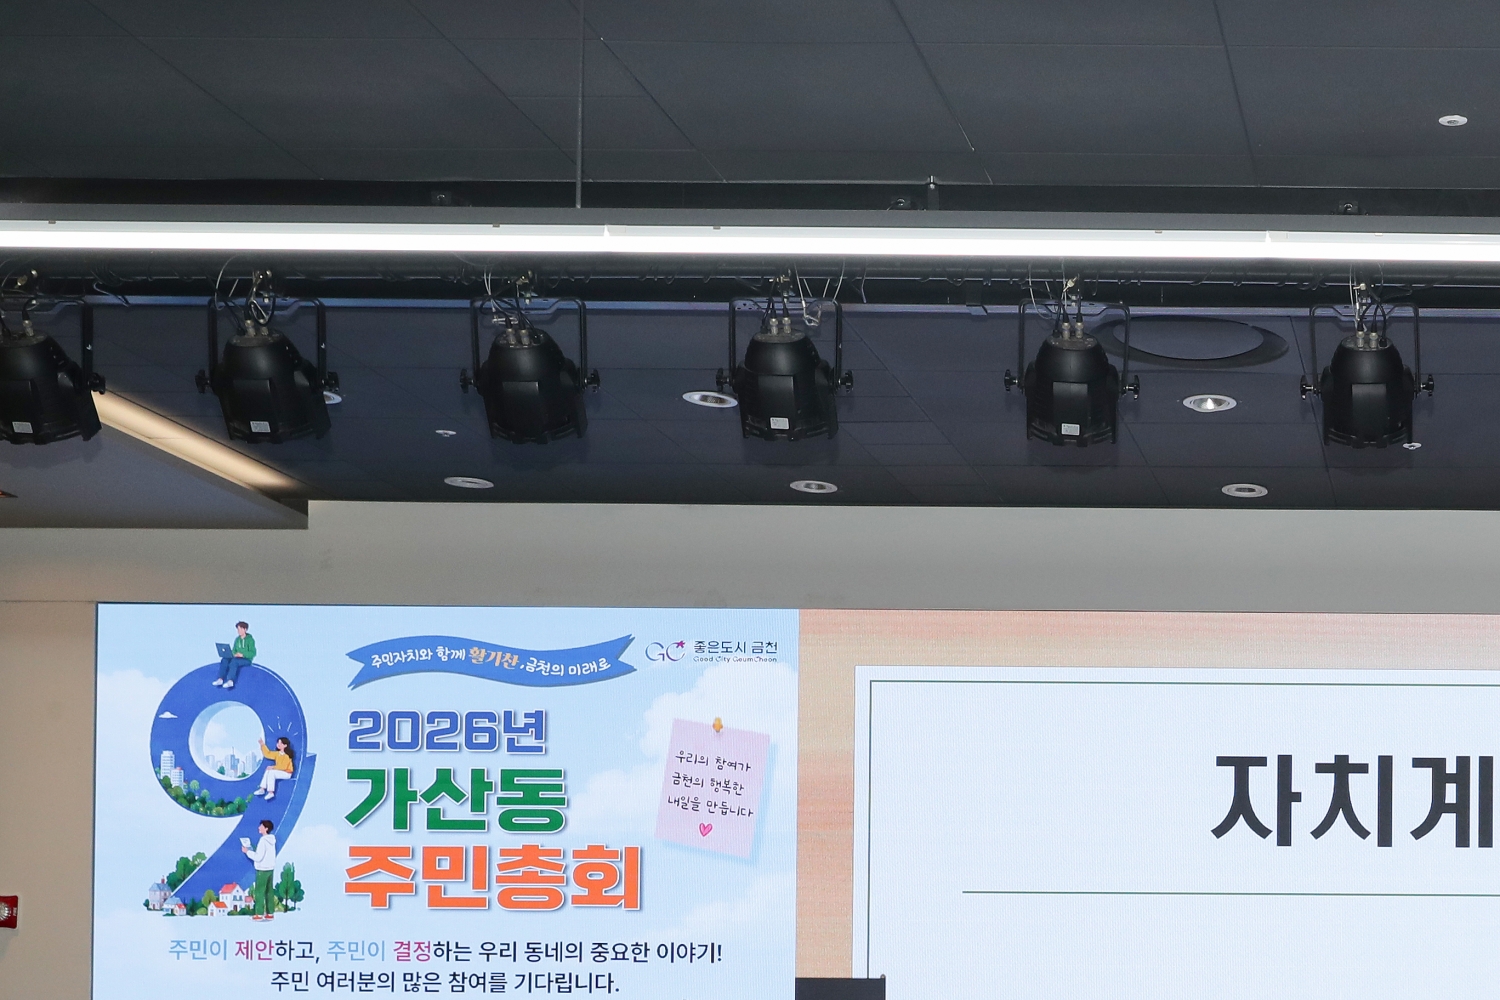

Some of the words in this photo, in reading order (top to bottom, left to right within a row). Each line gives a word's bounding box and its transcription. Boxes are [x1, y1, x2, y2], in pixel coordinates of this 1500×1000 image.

[694, 641, 746, 654] 좋은도시
[751, 641, 778, 654] 금천
[371, 648, 433, 668] 주민자치와
[437, 647, 465, 664] 함께
[568, 657, 611, 676] 미래로
[348, 708, 548, 755] 2026년
[676, 750, 709, 766] 우리의
[715, 756, 752, 772] 참여가
[672, 772, 704, 788] 금천의
[710, 778, 745, 796] 행복한
[343, 767, 569, 833] 가산동
[667, 796, 701, 812] 내일을
[706, 800, 754, 817] 만듭니다
[343, 843, 641, 911] 주민총회
[168, 939, 228, 961] 주민이
[235, 939, 320, 964] 제안하고,
[326, 940, 386, 962] 주민이
[393, 940, 472, 962] 결정하는
[478, 941, 517, 963] 우리
[524, 941, 583, 963] 동네의
[590, 942, 650, 963] 중요한
[656, 942, 723, 963] 이야기!
[270, 971, 309, 993] 주민
[316, 971, 395, 993] 여러분의
[402, 971, 442, 993] 많은
[448, 972, 508, 993] 참여를
[514, 972, 620, 994] 기다립니다.
